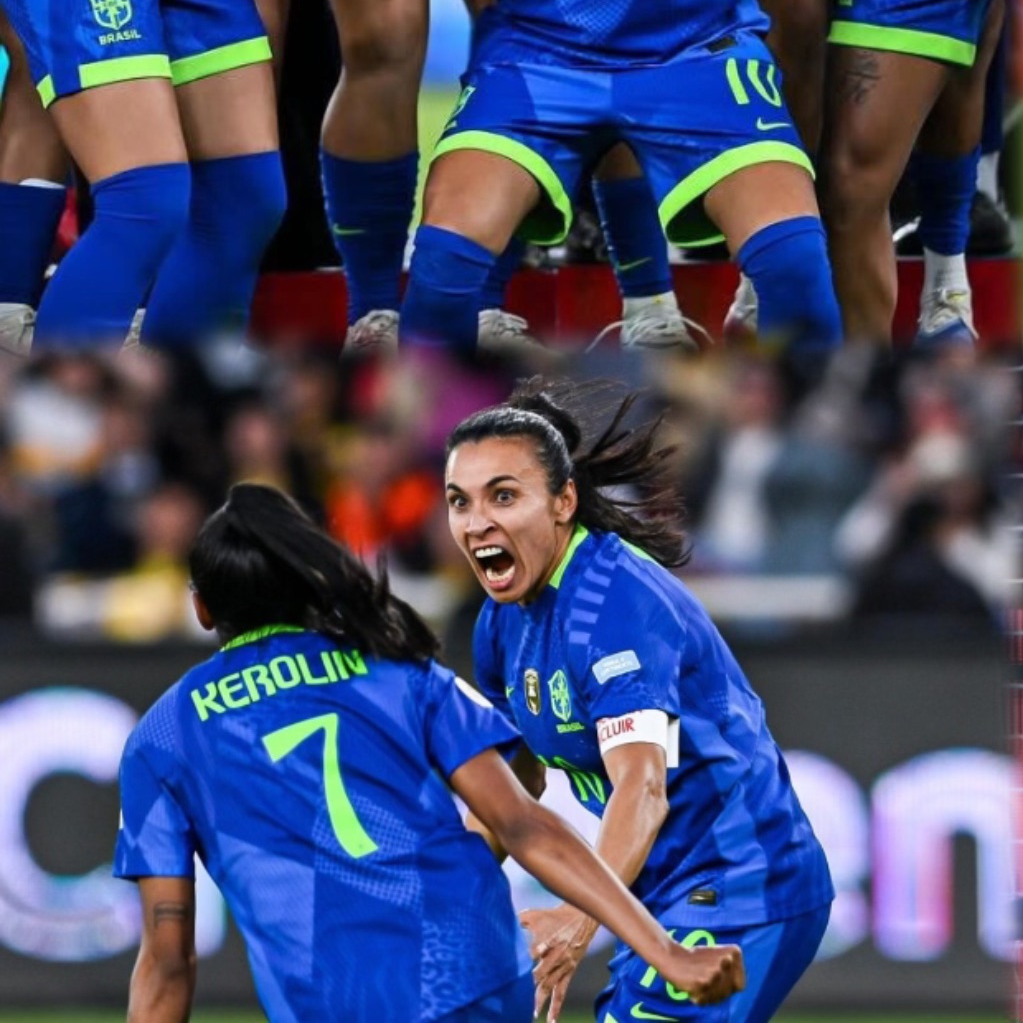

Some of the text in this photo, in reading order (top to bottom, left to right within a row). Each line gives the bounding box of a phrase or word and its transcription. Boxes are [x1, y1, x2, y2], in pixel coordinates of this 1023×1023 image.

[99, 29, 141, 46] BRASIL
[191, 649, 368, 722] KEROLIN
[261, 712, 378, 859] 7
